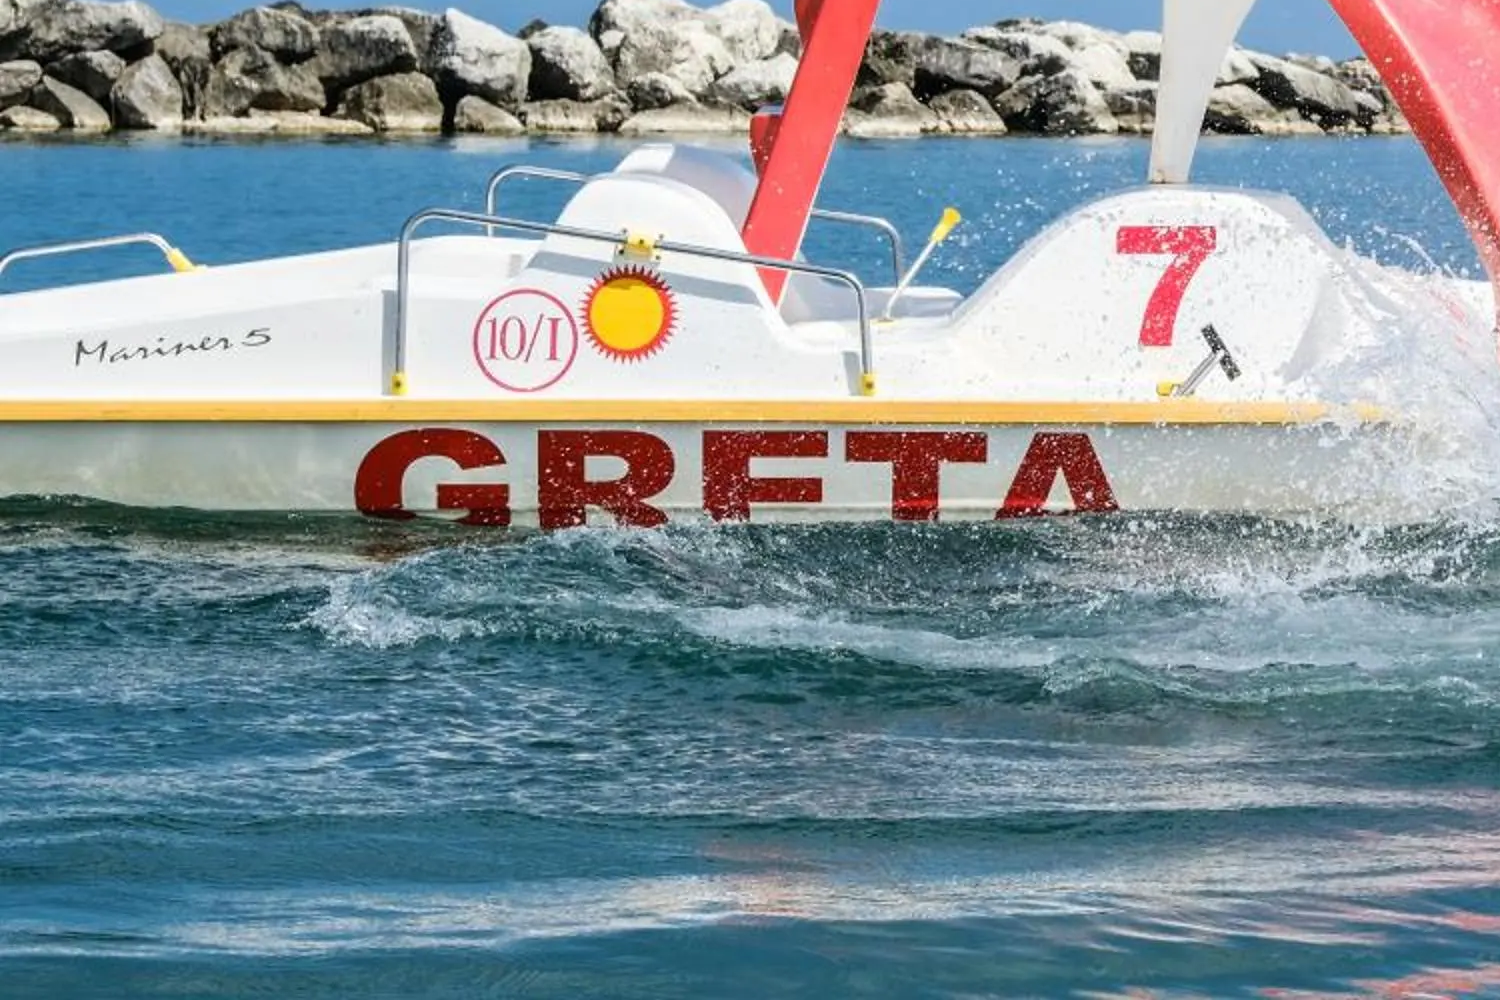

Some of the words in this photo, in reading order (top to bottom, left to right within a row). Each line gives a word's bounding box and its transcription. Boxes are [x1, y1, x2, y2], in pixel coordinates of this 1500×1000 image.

[1116, 226, 1216, 346] 7
[75, 336, 233, 366] Mariner
[242, 327, 272, 347] 5
[354, 428, 1120, 528] GRETA
